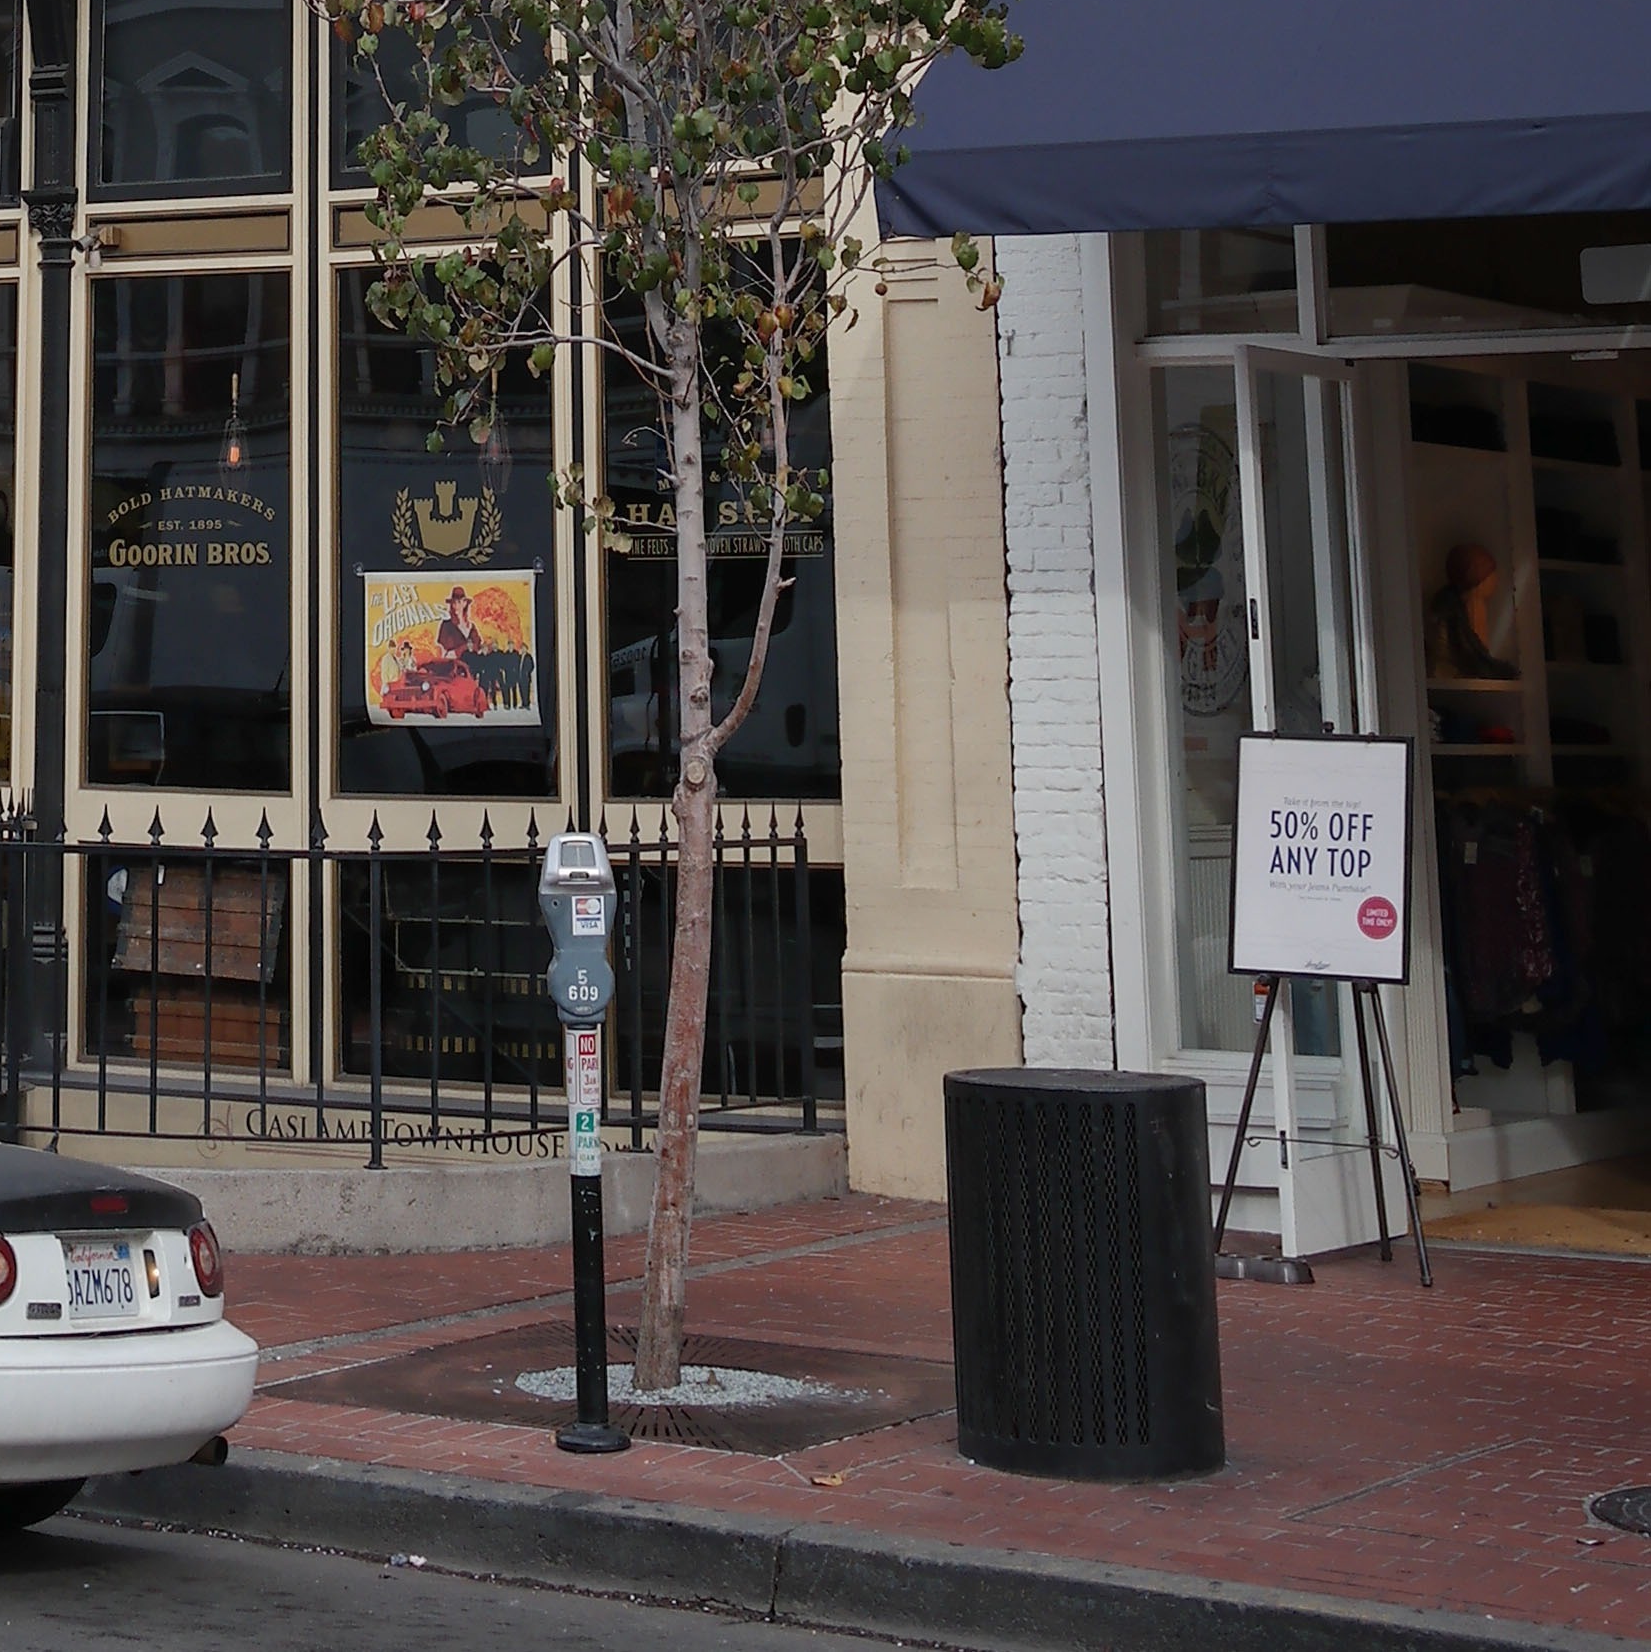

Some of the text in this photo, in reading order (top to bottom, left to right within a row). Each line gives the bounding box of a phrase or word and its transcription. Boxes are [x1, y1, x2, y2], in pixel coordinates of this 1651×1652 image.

[107, 485, 276, 524] BOLD HATMAKERS
[626, 502, 679, 528] HA
[157, 519, 223, 531] EST. 1895
[108, 538, 273, 567] GOORIN BROS.
[647, 538, 669, 555] FELTS
[705, 537, 732, 555] OVEN
[732, 537, 767, 554] STRAWS
[783, 537, 801, 553] OTH
[803, 536, 824, 552] CAPS
[384, 584, 420, 615] LAST
[372, 602, 451, 647] ORIGINALS
[1270, 810, 1374, 842] 50% OFF
[1269, 845, 1372, 878] ANY TOP
[1366, 908, 1389, 917] LIMITED
[579, 921, 599, 930] VISA
[577, 969, 588, 985] 5
[568, 985, 599, 1001] 609
[580, 1036, 595, 1053] NO
[580, 1114, 590, 1131] 2
[69, 1245, 119, 1268] California
